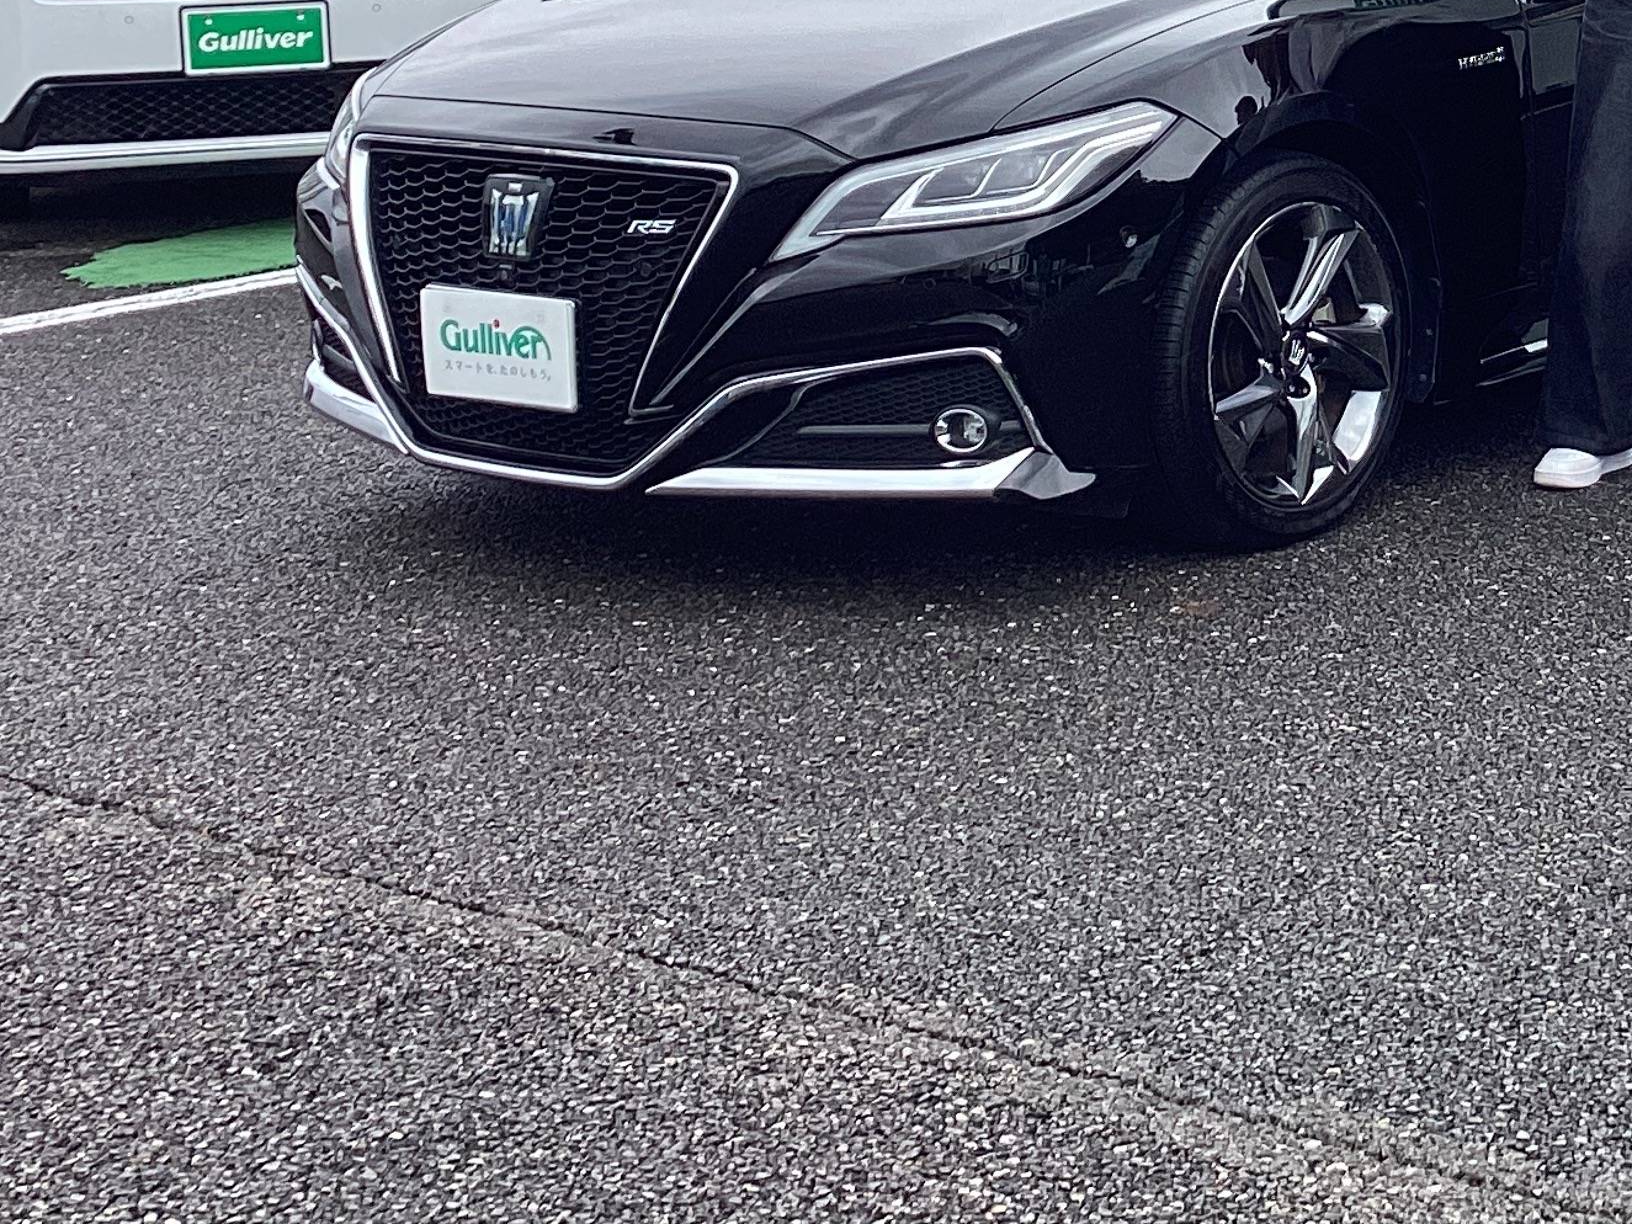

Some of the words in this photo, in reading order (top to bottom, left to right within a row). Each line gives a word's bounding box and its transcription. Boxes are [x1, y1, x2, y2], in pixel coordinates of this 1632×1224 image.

[198, 27, 313, 52] Gulliver
[627, 219, 676, 234] RS
[440, 319, 551, 361] Gulliver
